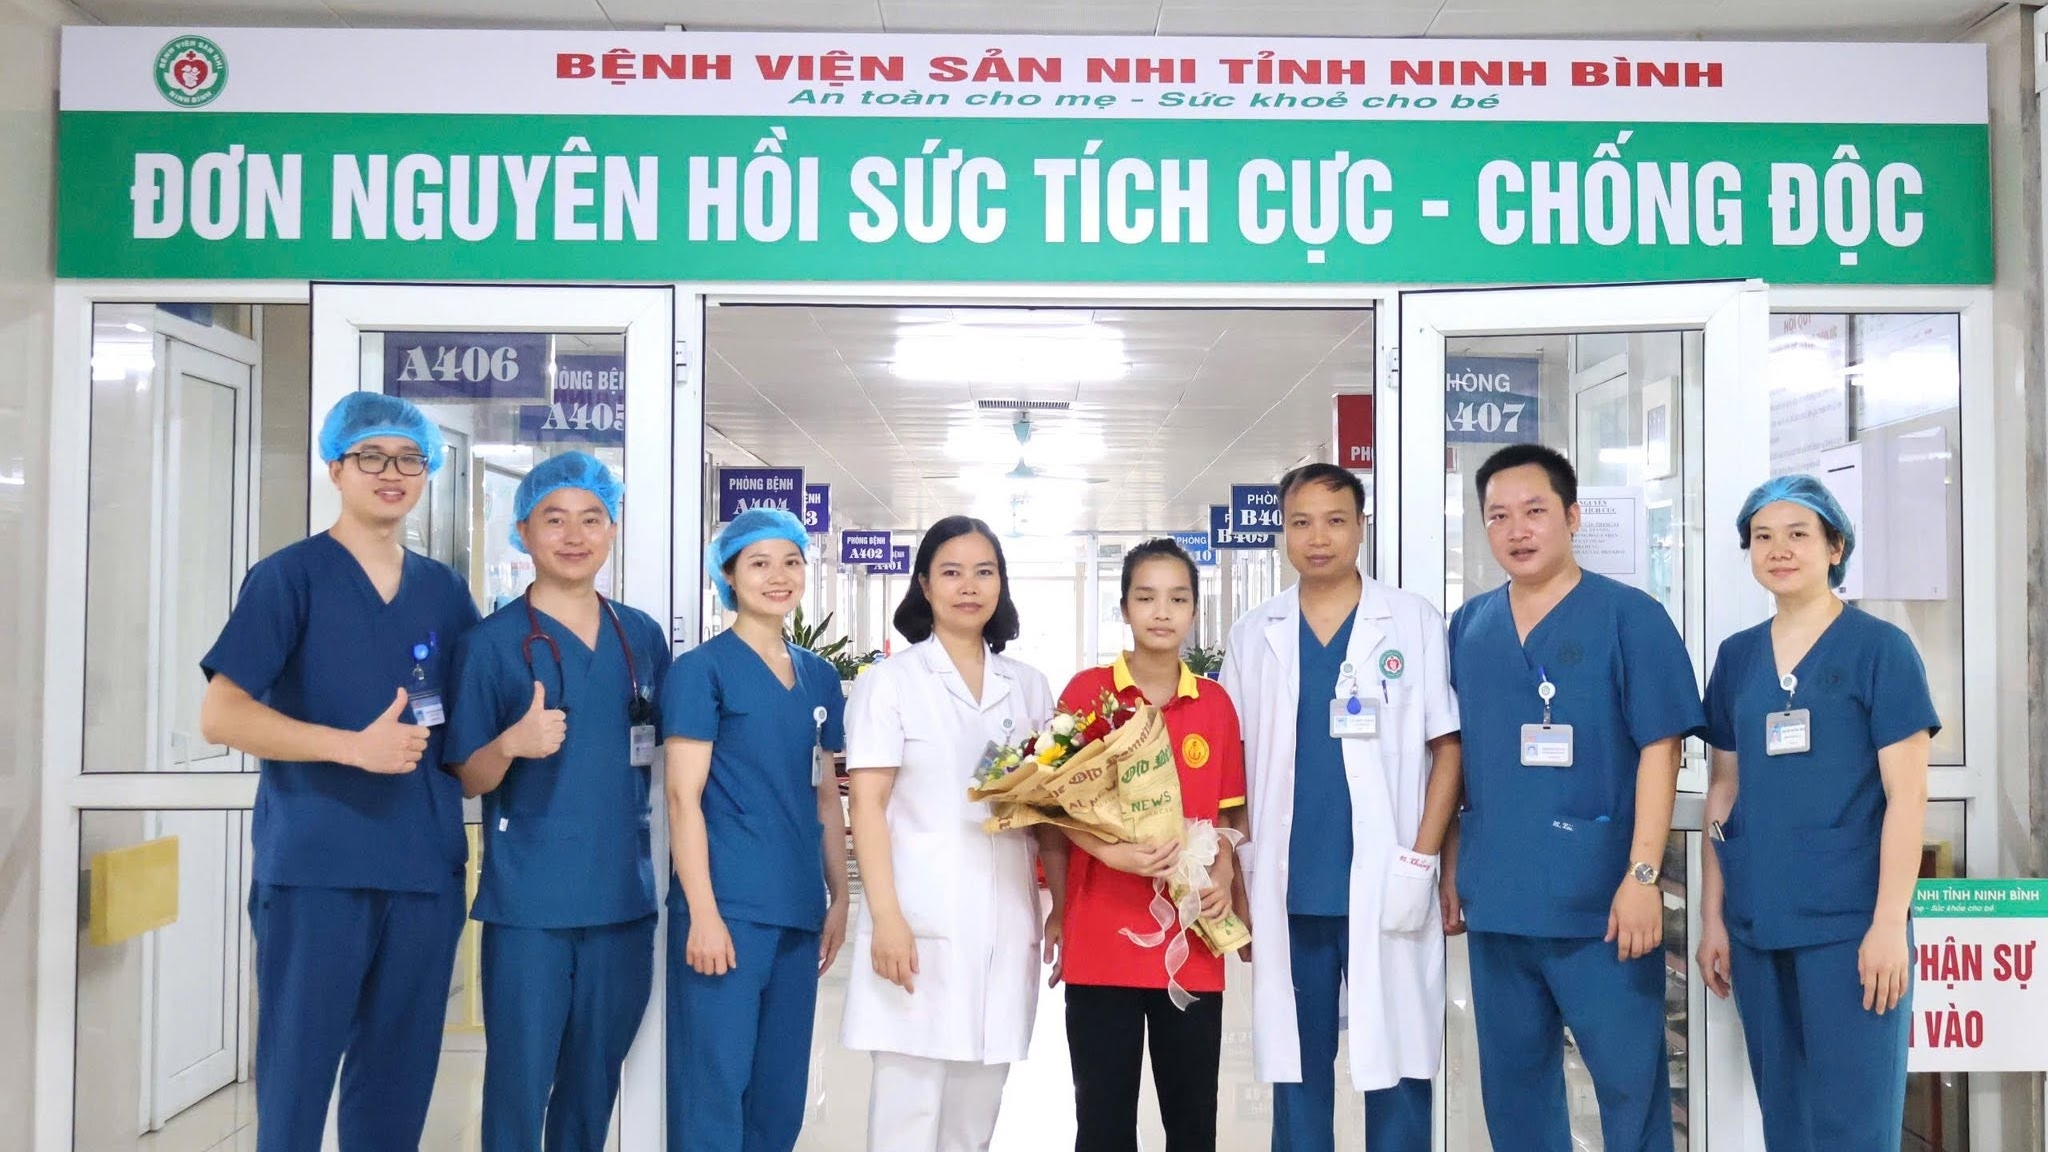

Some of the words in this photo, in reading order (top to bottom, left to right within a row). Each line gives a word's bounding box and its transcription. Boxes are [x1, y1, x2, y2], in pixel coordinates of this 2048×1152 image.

[556, 48, 731, 85] BỆNH
[755, 50, 904, 87] VIỆN
[928, 48, 1061, 83] SẢN
[1086, 58, 1196, 83] NHI
[1219, 51, 1365, 85] TỈNH
[1390, 61, 1546, 86] NINH
[1571, 56, 1723, 87] BÌNH
[787, 89, 845, 105] An
[860, 89, 949, 106] toàn
[965, 91, 1042, 107] cho
[1055, 95, 1117, 109] mẹ
[1157, 91, 1235, 108] Sức
[1249, 91, 1348, 109] khoẻ
[1363, 93, 1438, 110] cho
[1450, 92, 1500, 110] bé
[131, 144, 301, 240] ĐƠN
[332, 136, 659, 242] NGUYÊN
[688, 126, 819, 242] HỒI
[849, 138, 1006, 244] SỨC
[1034, 140, 1208, 244] TÍCH
[1238, 151, 1392, 263] CỰC
[1422, 200, 1448, 217] -
[1478, 130, 1742, 247] CHỐNG
[1768, 144, 1923, 265] ĐỘC
[397, 346, 519, 382] A406
[541, 401, 624, 431] A405
[1351, 446, 1373, 462] PH
[729, 475, 764, 491] PHÒNG
[766, 477, 794, 493] BỆNH
[847, 536, 868, 545] PHÒNG
[869, 536, 886, 546] BỆNH
[849, 549, 884, 559] A402
[1131, 790, 1172, 812] NEWS
[1917, 890, 1939, 900] NHI
[1943, 886, 1971, 900] TỈNH
[1974, 890, 2006, 900] NINH
[2009, 886, 2040, 900] BÌNH
[1993, 940, 2037, 990] SỰ
[1925, 1003, 1984, 1049] VÀO
